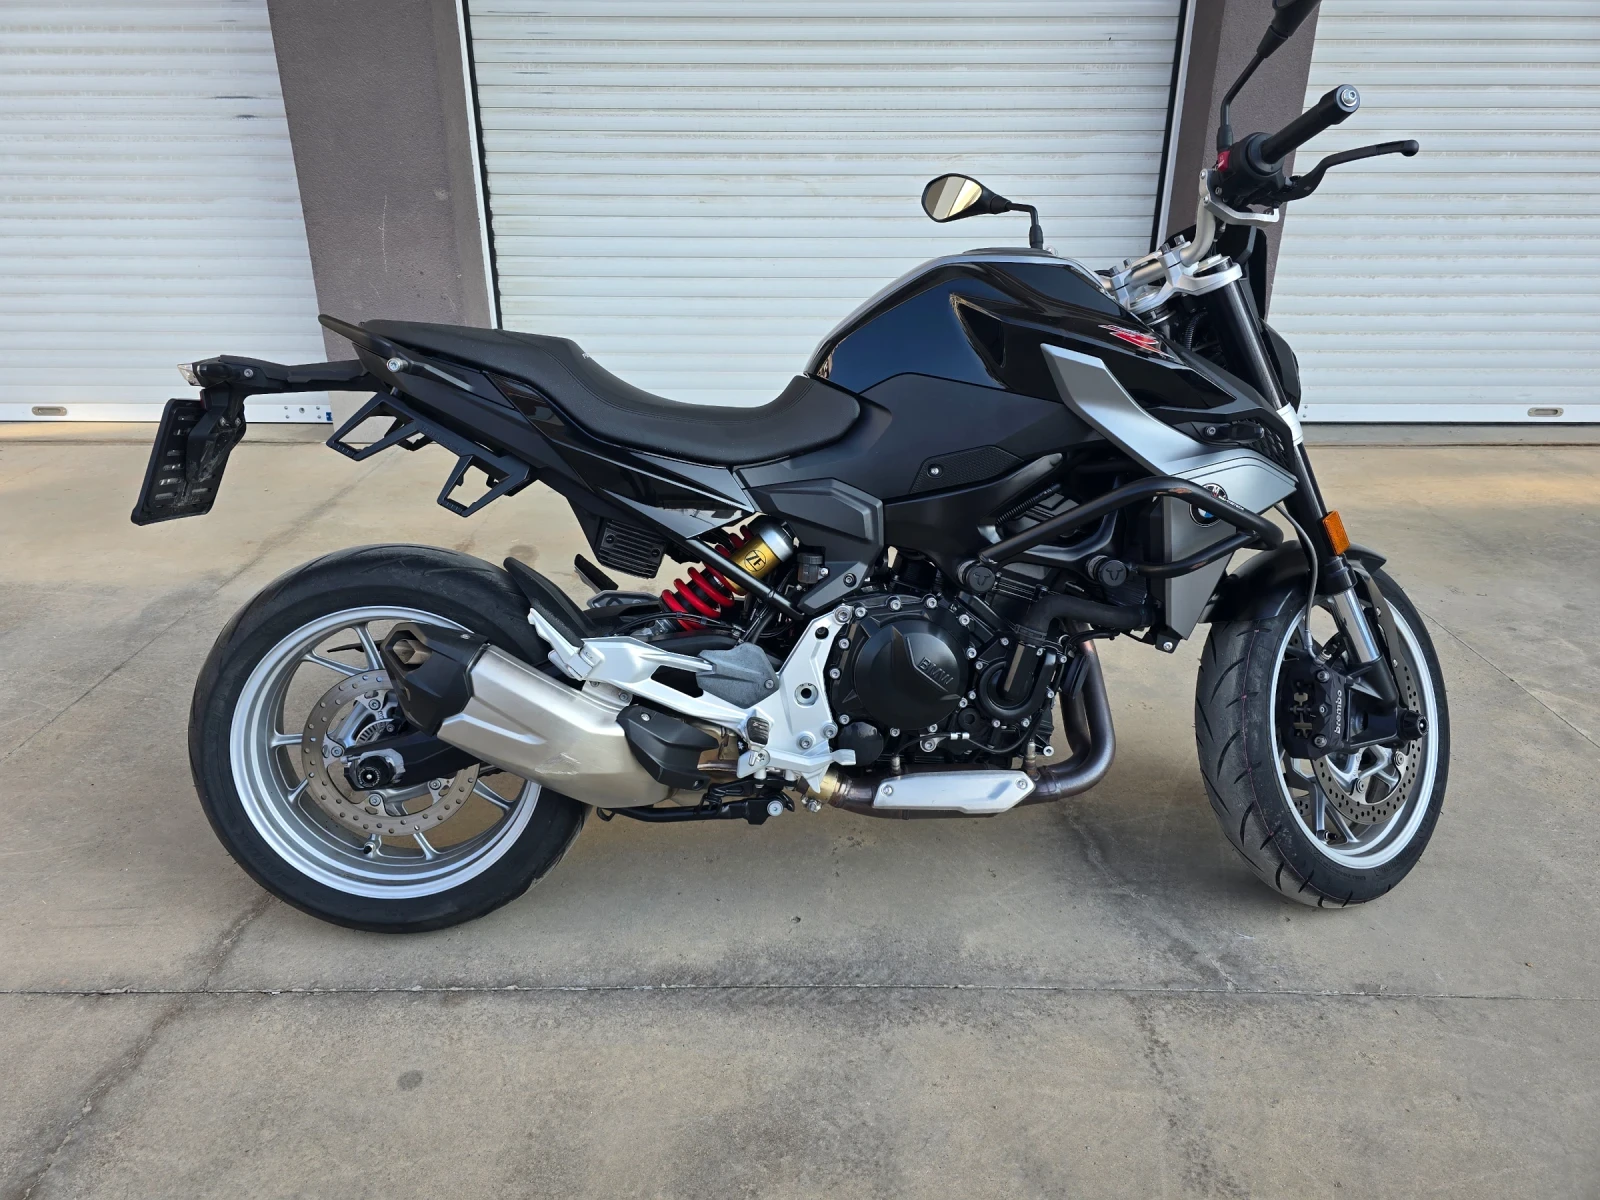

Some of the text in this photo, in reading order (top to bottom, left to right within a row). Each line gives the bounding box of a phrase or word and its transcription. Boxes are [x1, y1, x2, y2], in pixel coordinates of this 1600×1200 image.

[745, 550, 766, 571] ZF
[918, 657, 954, 685] BMW
[1334, 689, 1342, 734] brembo
